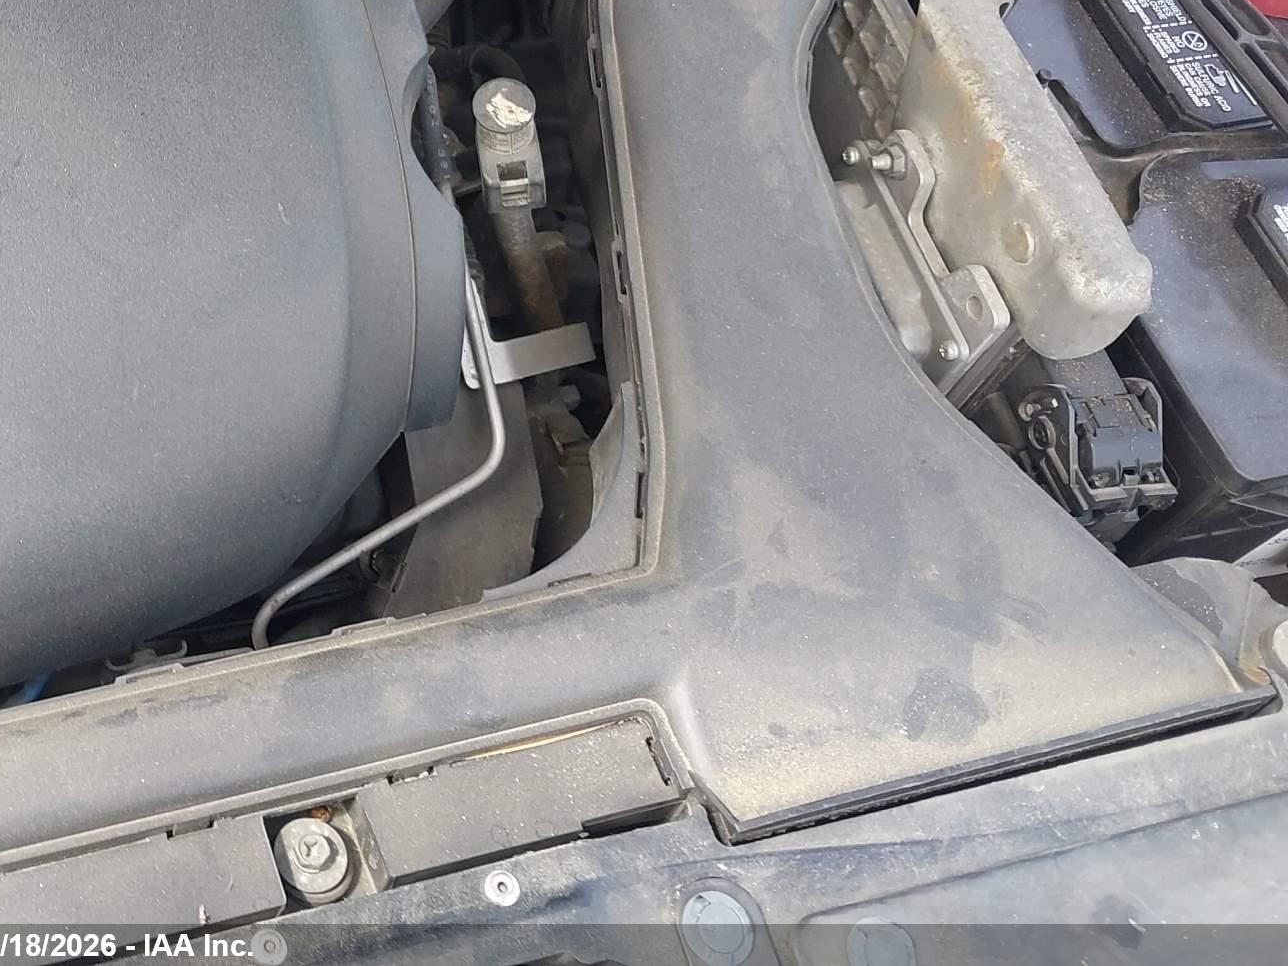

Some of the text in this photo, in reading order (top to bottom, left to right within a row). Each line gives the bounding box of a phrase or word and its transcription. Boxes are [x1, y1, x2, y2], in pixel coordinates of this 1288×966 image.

[1157, 0, 1174, 17] EYES
[1172, 36, 1186, 48] NO
[1177, 64, 1211, 107] BLINDNESS OR
[1184, 63, 1212, 96] CAN CAUSE
[1192, 62, 1232, 112] SULFURIC ACID
